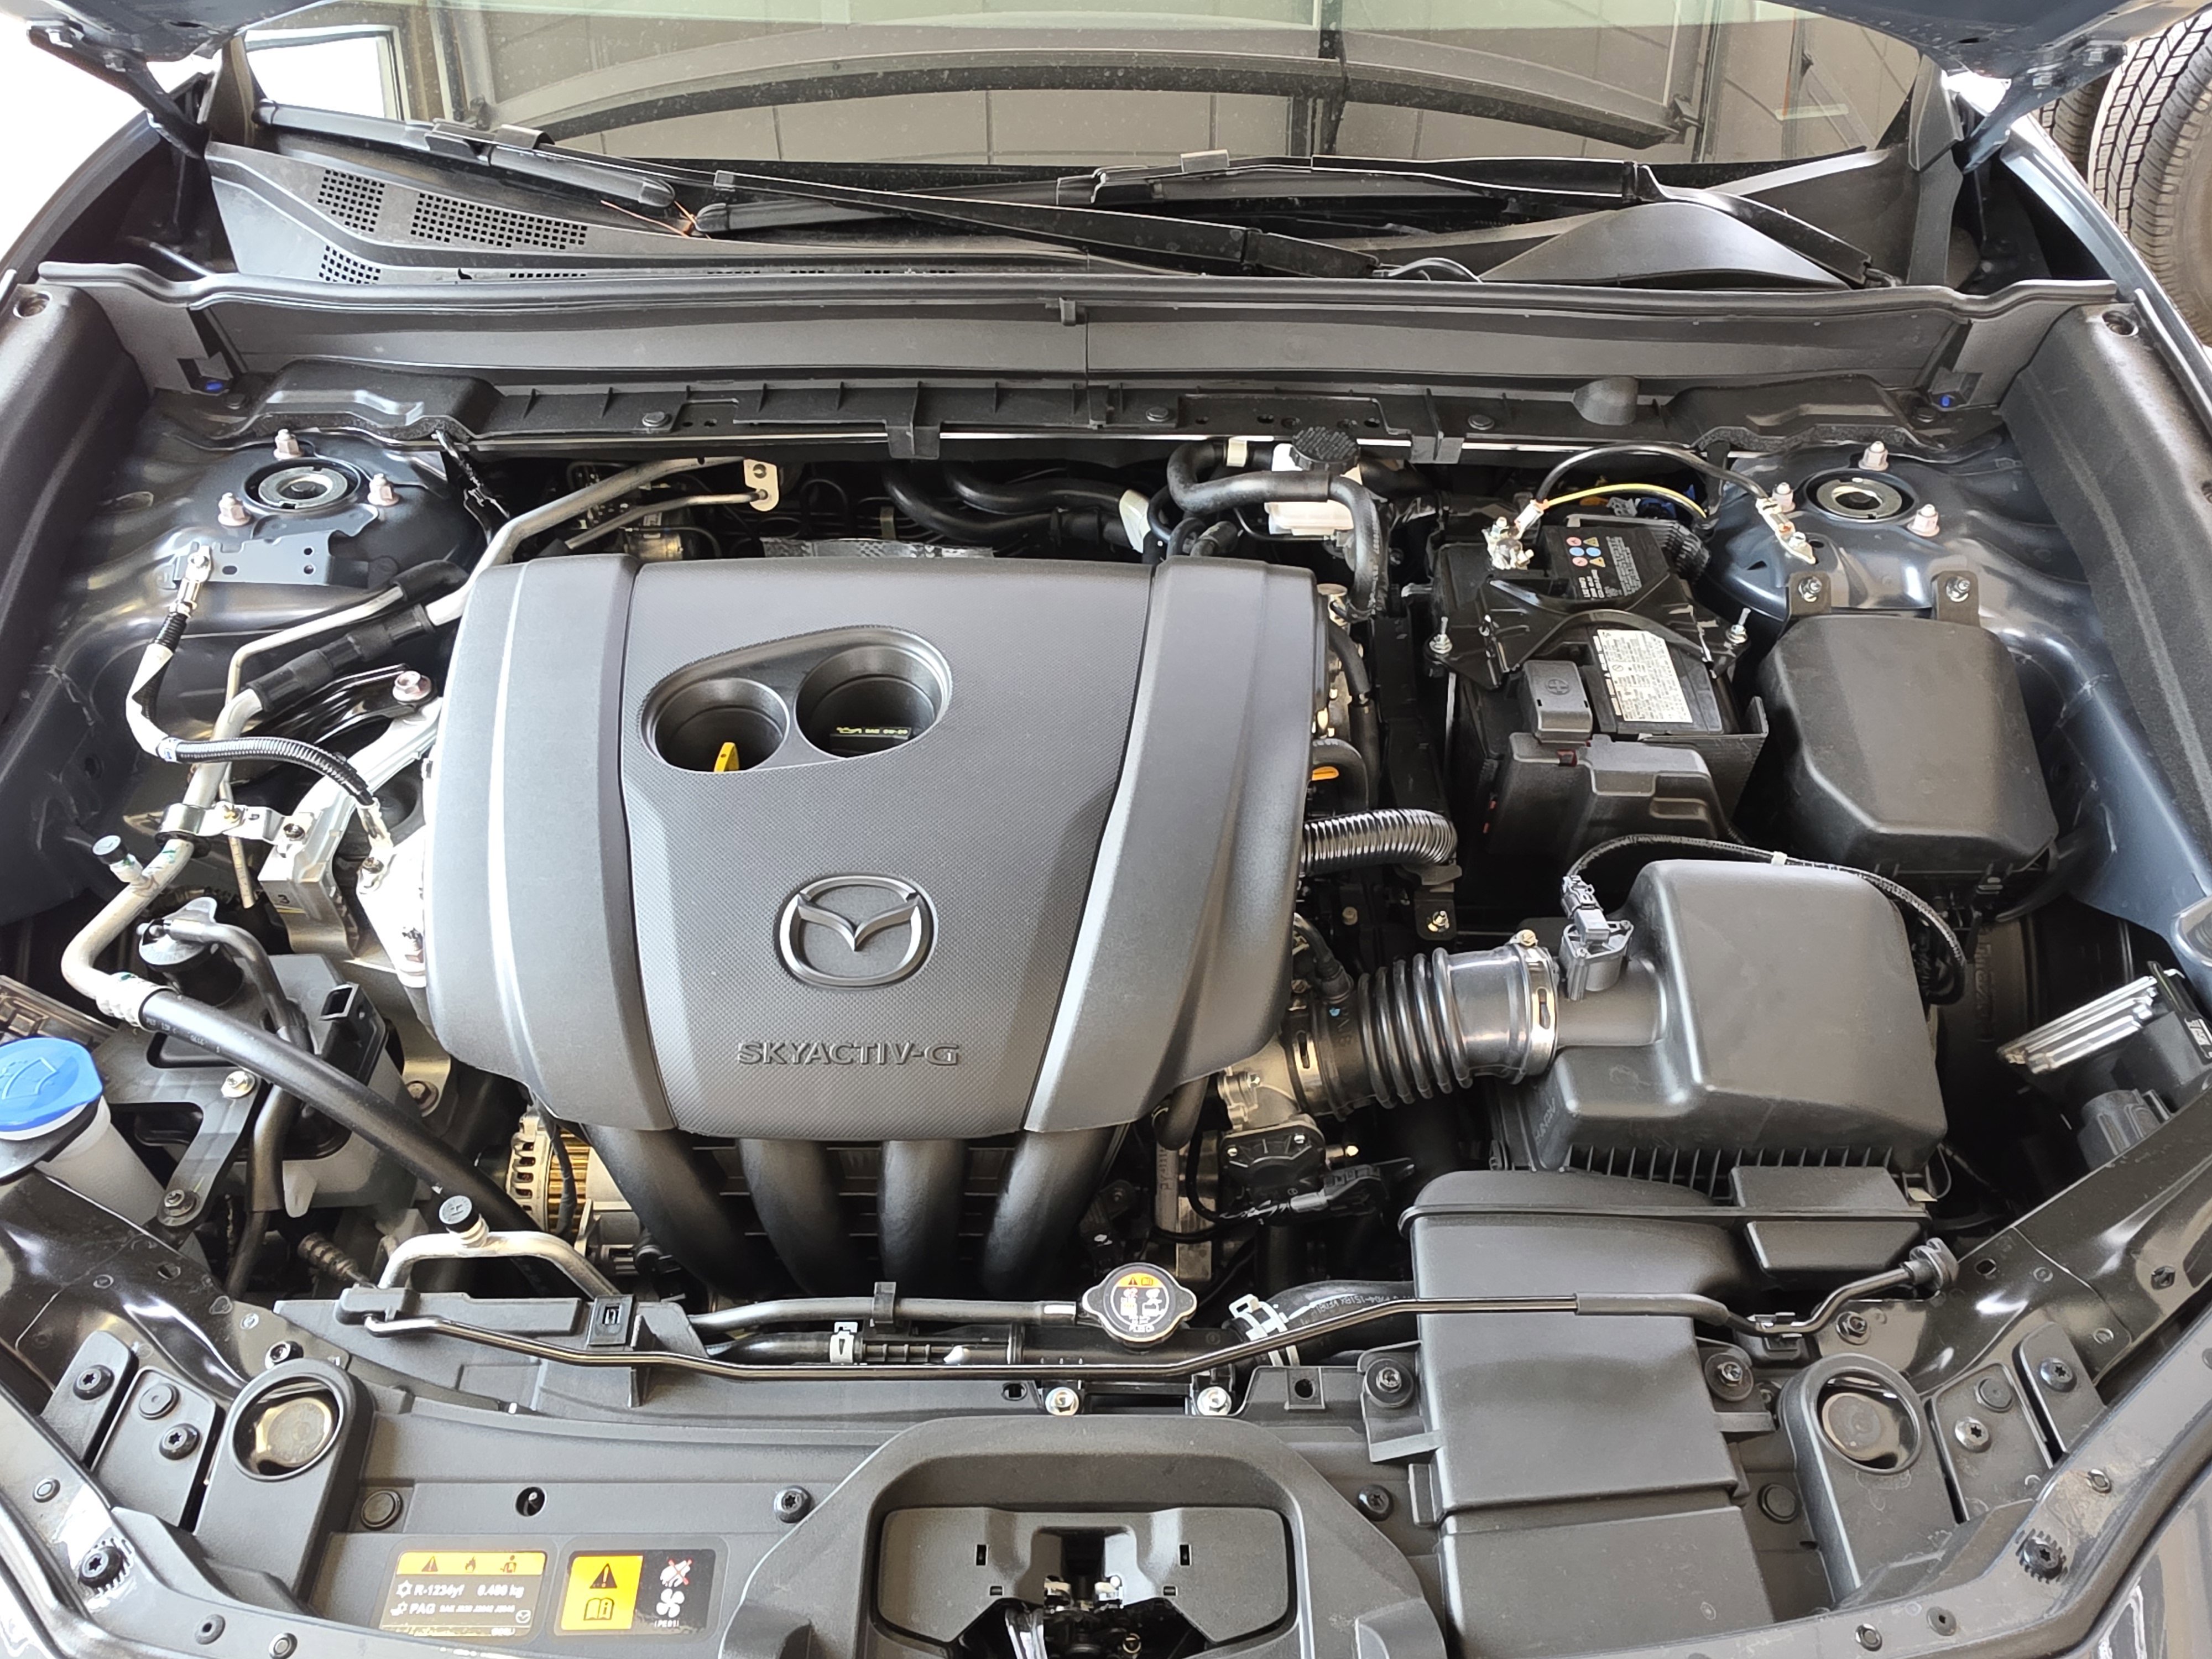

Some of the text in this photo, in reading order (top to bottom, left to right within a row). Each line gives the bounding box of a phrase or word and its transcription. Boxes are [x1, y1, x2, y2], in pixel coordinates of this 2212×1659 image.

[737, 1041, 959, 1066] SKYACTIV-G
[413, 1584, 465, 1599] R-1234yf
[509, 1584, 525, 1599] kg
[409, 1603, 436, 1614] PAG
